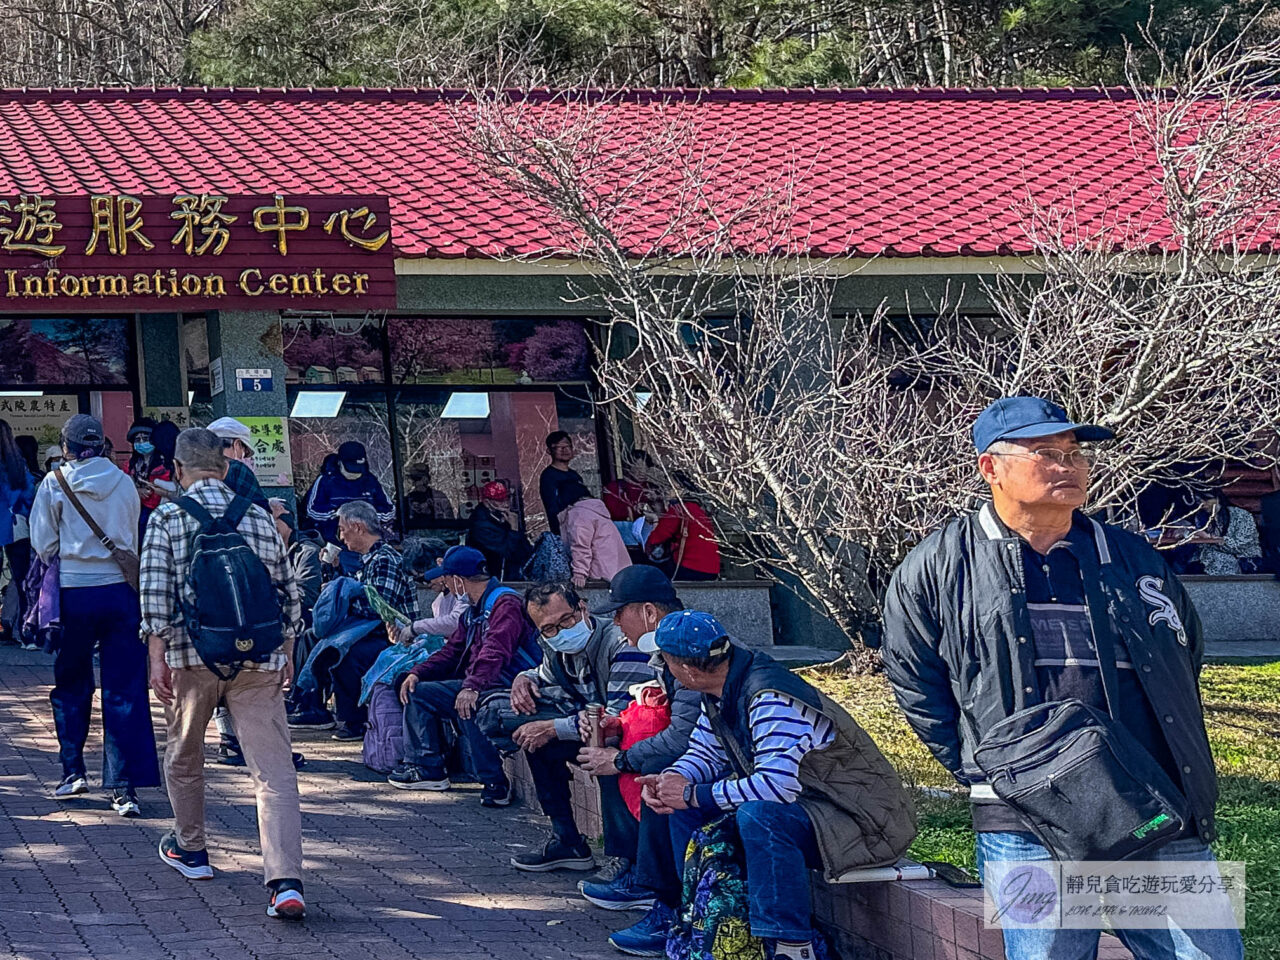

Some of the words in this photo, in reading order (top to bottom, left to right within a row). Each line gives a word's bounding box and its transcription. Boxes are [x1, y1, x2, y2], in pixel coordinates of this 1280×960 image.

[4, 268, 228, 298] Information
[238, 268, 371, 297] Center
[253, 378, 262, 391] 5
